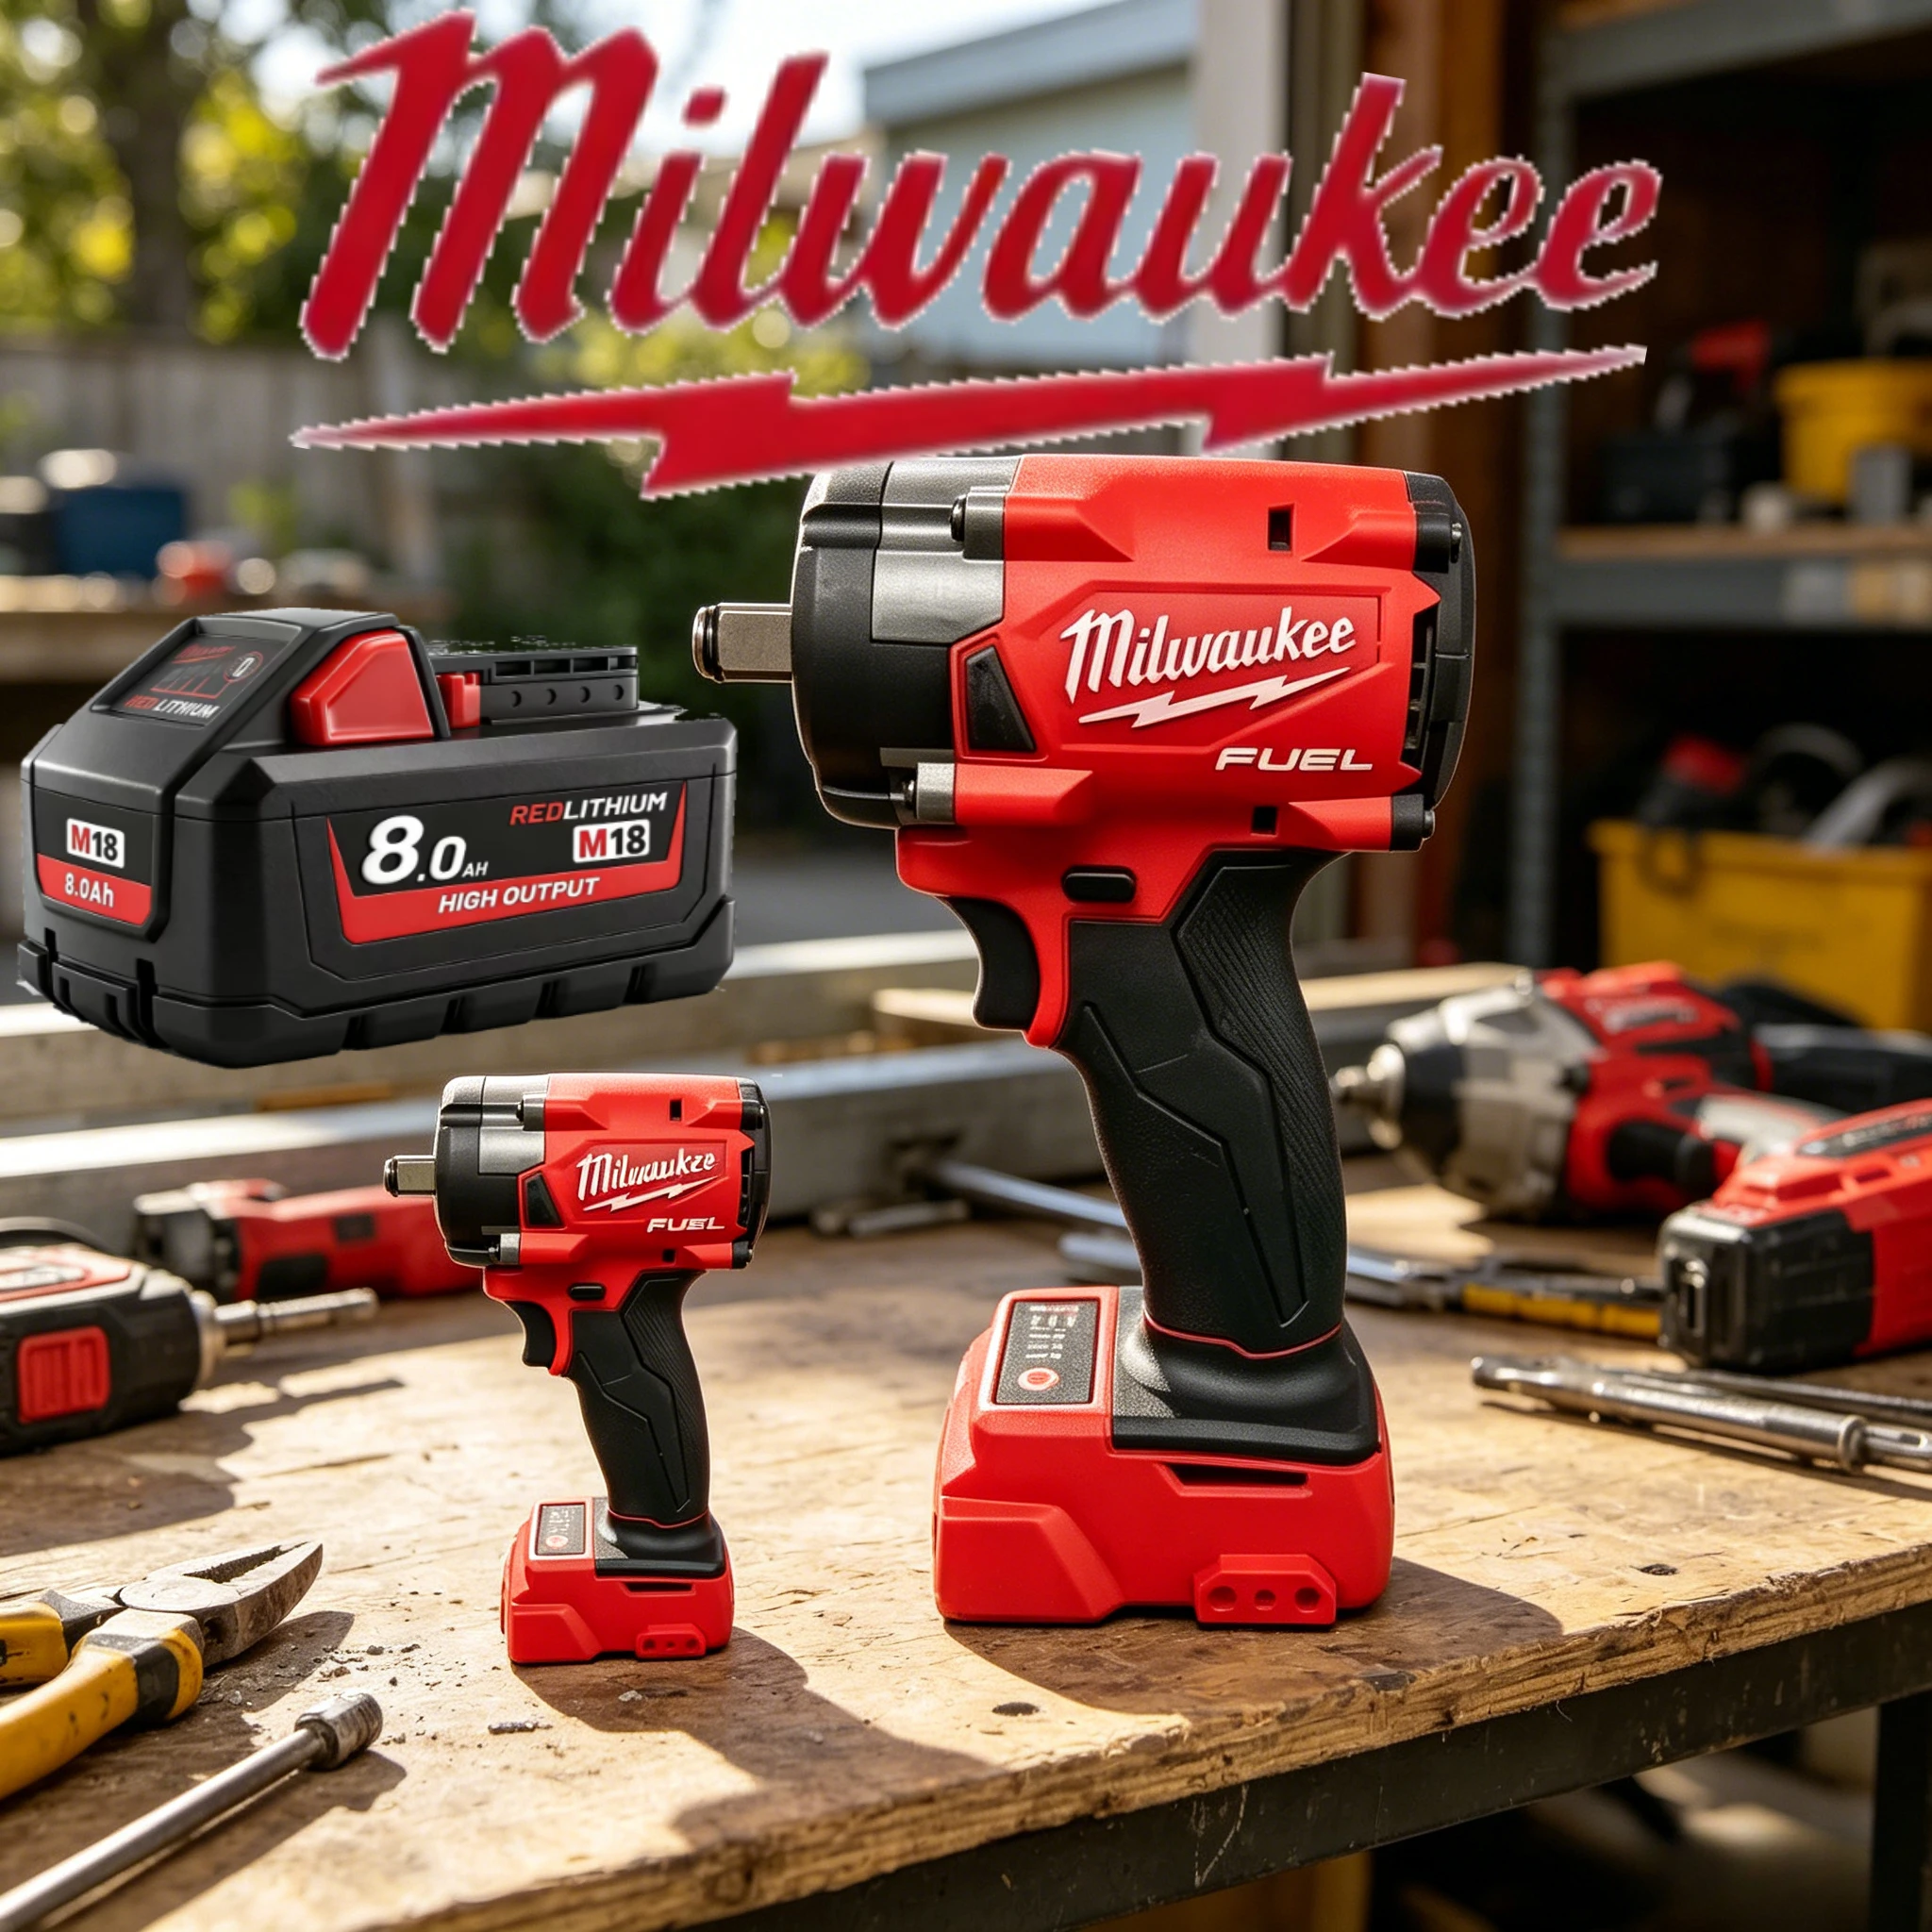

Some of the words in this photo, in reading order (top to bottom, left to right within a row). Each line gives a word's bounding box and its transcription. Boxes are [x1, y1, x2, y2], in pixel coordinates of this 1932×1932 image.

[1059, 606, 1357, 704] Milwaukee
[1215, 747, 1373, 771] FUEL
[509, 791, 668, 825] REDLITHIUM
[71, 824, 119, 862] M18
[578, 824, 646, 859] M18
[64, 873, 114, 908] 8.0Ah
[438, 888, 499, 914] HIGH
[502, 877, 600, 906] OUTPUT
